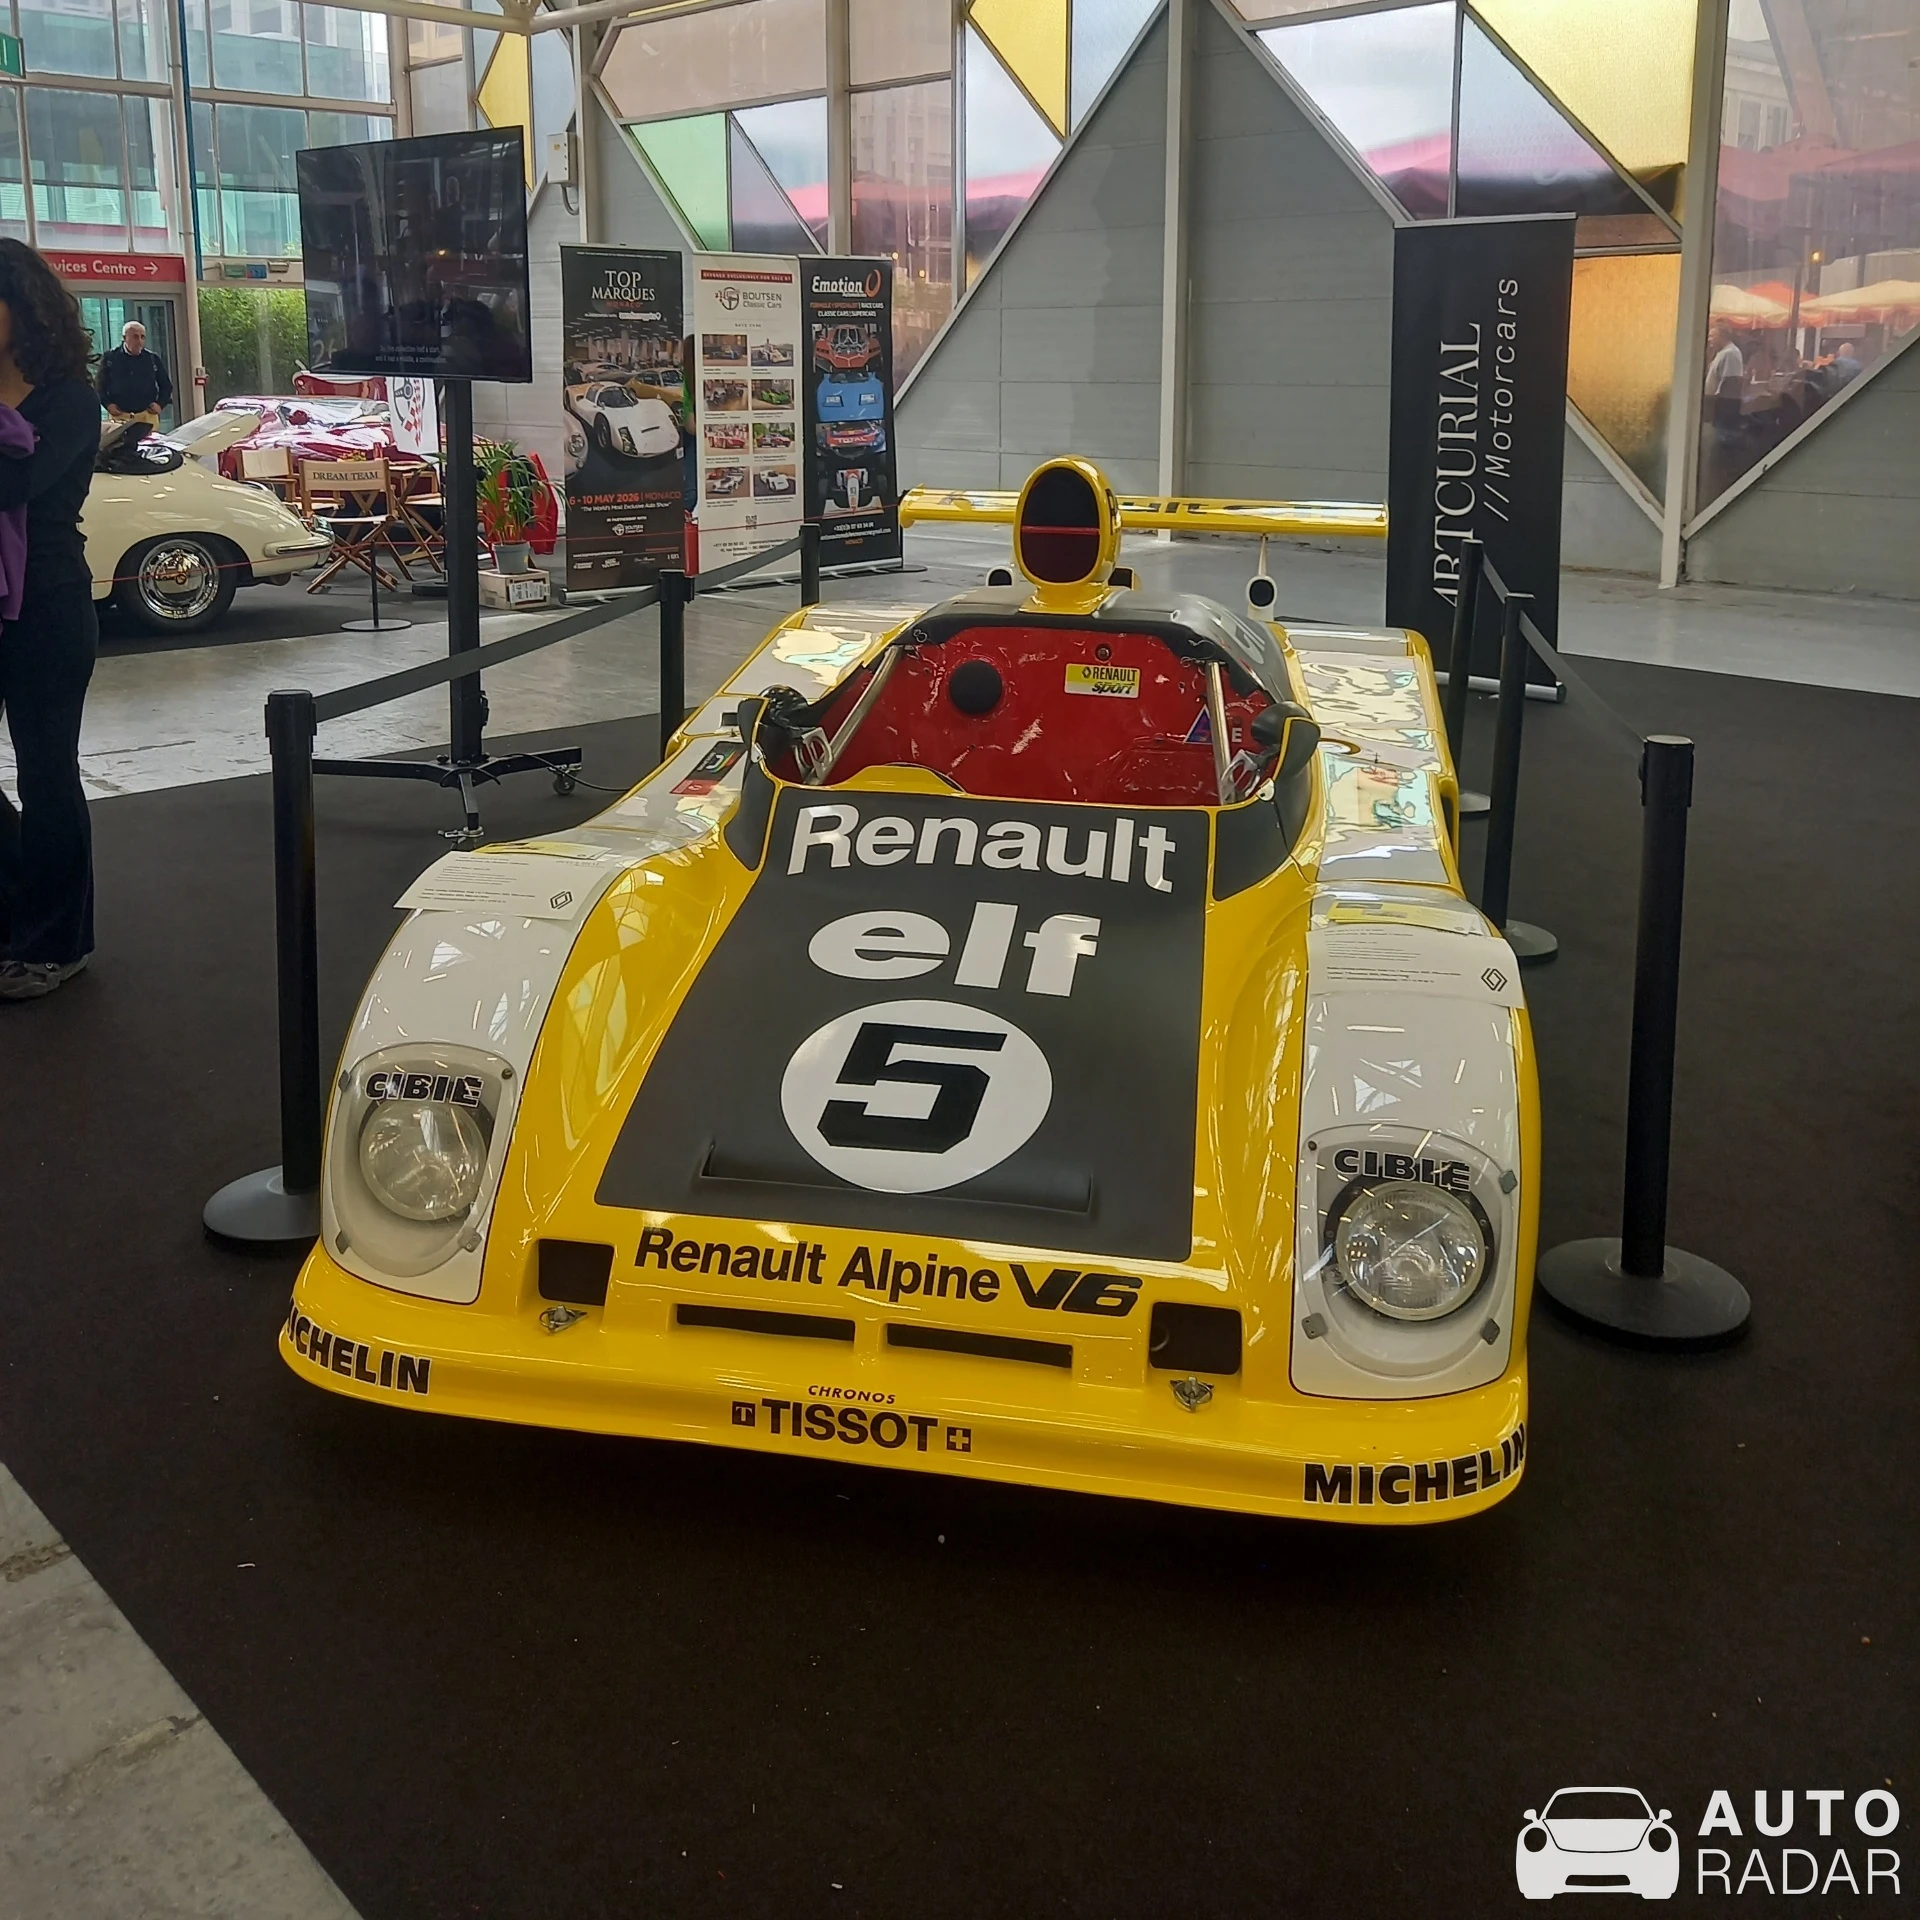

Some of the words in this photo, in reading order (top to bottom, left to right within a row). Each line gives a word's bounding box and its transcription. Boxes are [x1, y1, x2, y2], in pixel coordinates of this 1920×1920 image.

[49, 259, 87, 273] vices
[92, 260, 137, 275] Centre
[604, 270, 642, 288] TOP
[812, 275, 865, 293] Emotion
[591, 287, 656, 302] MARQUES
[742, 292, 782, 301] BOUTSEN
[742, 301, 765, 309] Classic
[766, 301, 782, 309] Cars
[834, 436, 867, 444] TOTAL
[1433, 322, 1481, 608] ARTCURIAL
[313, 471, 348, 481] DREAM
[351, 471, 378, 480] TEAM
[582, 494, 593, 504] 10
[594, 493, 615, 504] MAY
[617, 492, 640, 503] 2026
[644, 490, 681, 500] MONACO
[623, 502, 644, 510] Exclusive
[1092, 666, 1138, 682] RENAULT
[1091, 681, 1136, 695] sport
[1231, 727, 1242, 743] E
[787, 803, 1177, 893] Renault
[807, 901, 1102, 997] elf
[817, 1022, 1008, 1154] 5
[634, 1226, 827, 1284] Renault
[838, 1246, 1001, 1303] Alpine
[1009, 1263, 1144, 1318] V6
[807, 1385, 897, 1405] CHRONOS
[760, 1397, 939, 1452] TISSOT
[1302, 1422, 1527, 1507] MICHELIN
